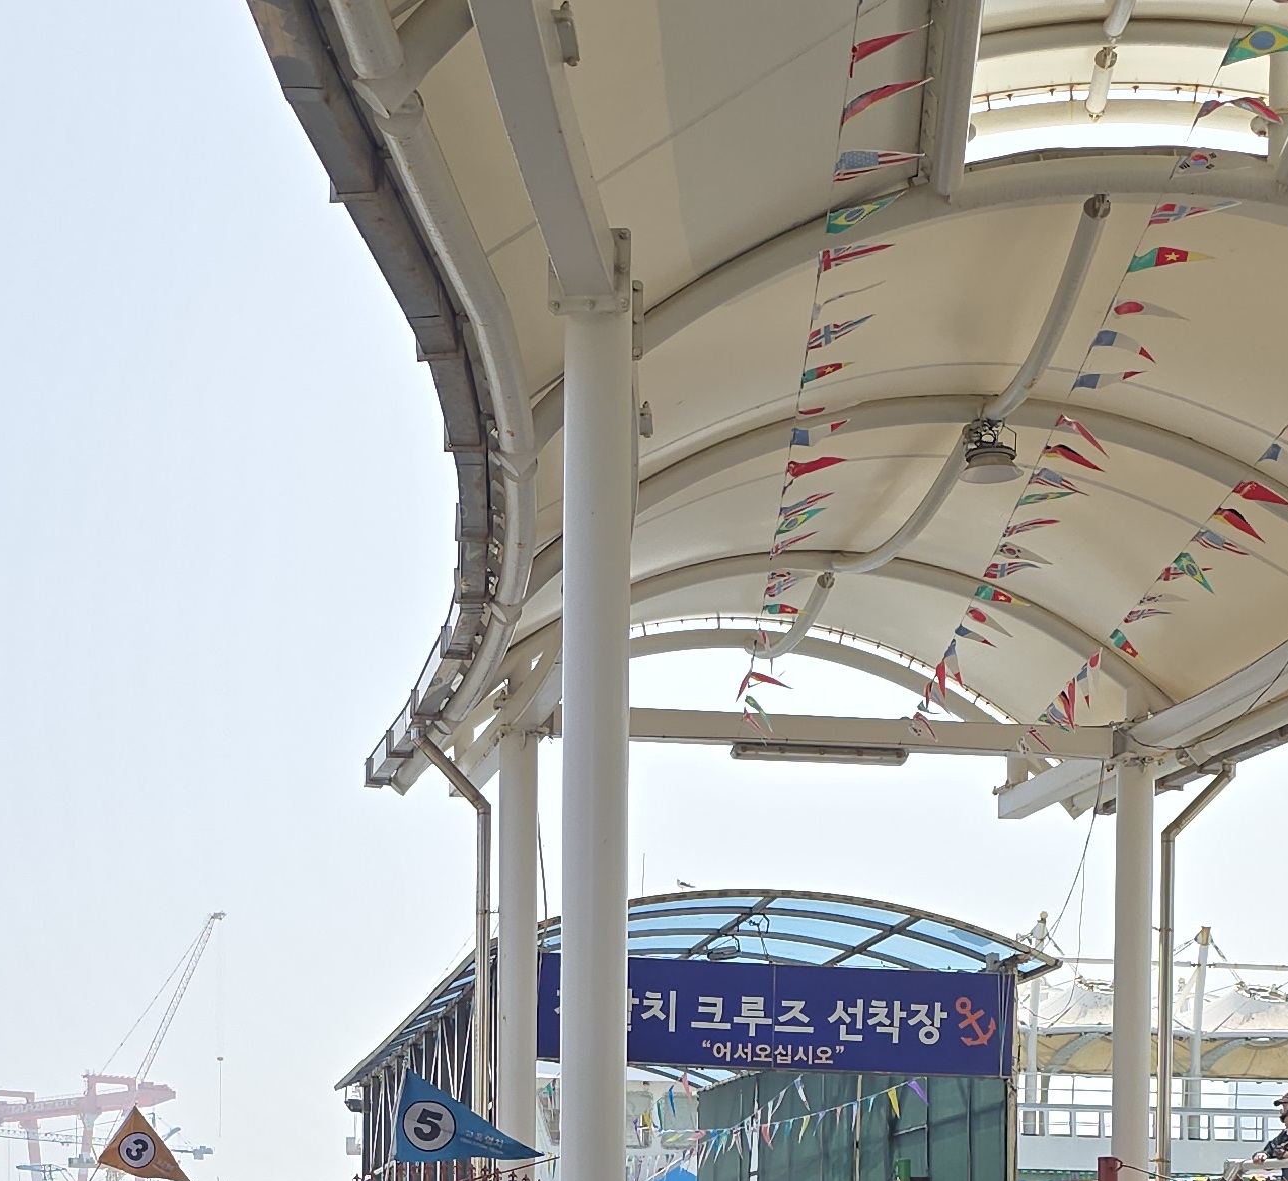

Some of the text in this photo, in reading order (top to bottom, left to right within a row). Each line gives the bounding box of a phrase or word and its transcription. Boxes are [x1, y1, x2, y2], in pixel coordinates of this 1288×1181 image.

[690, 995, 814, 1037] 크루즈
[827, 999, 948, 1045] 선착장
[413, 1108, 443, 1142] 5
[125, 1138, 149, 1161] 3
